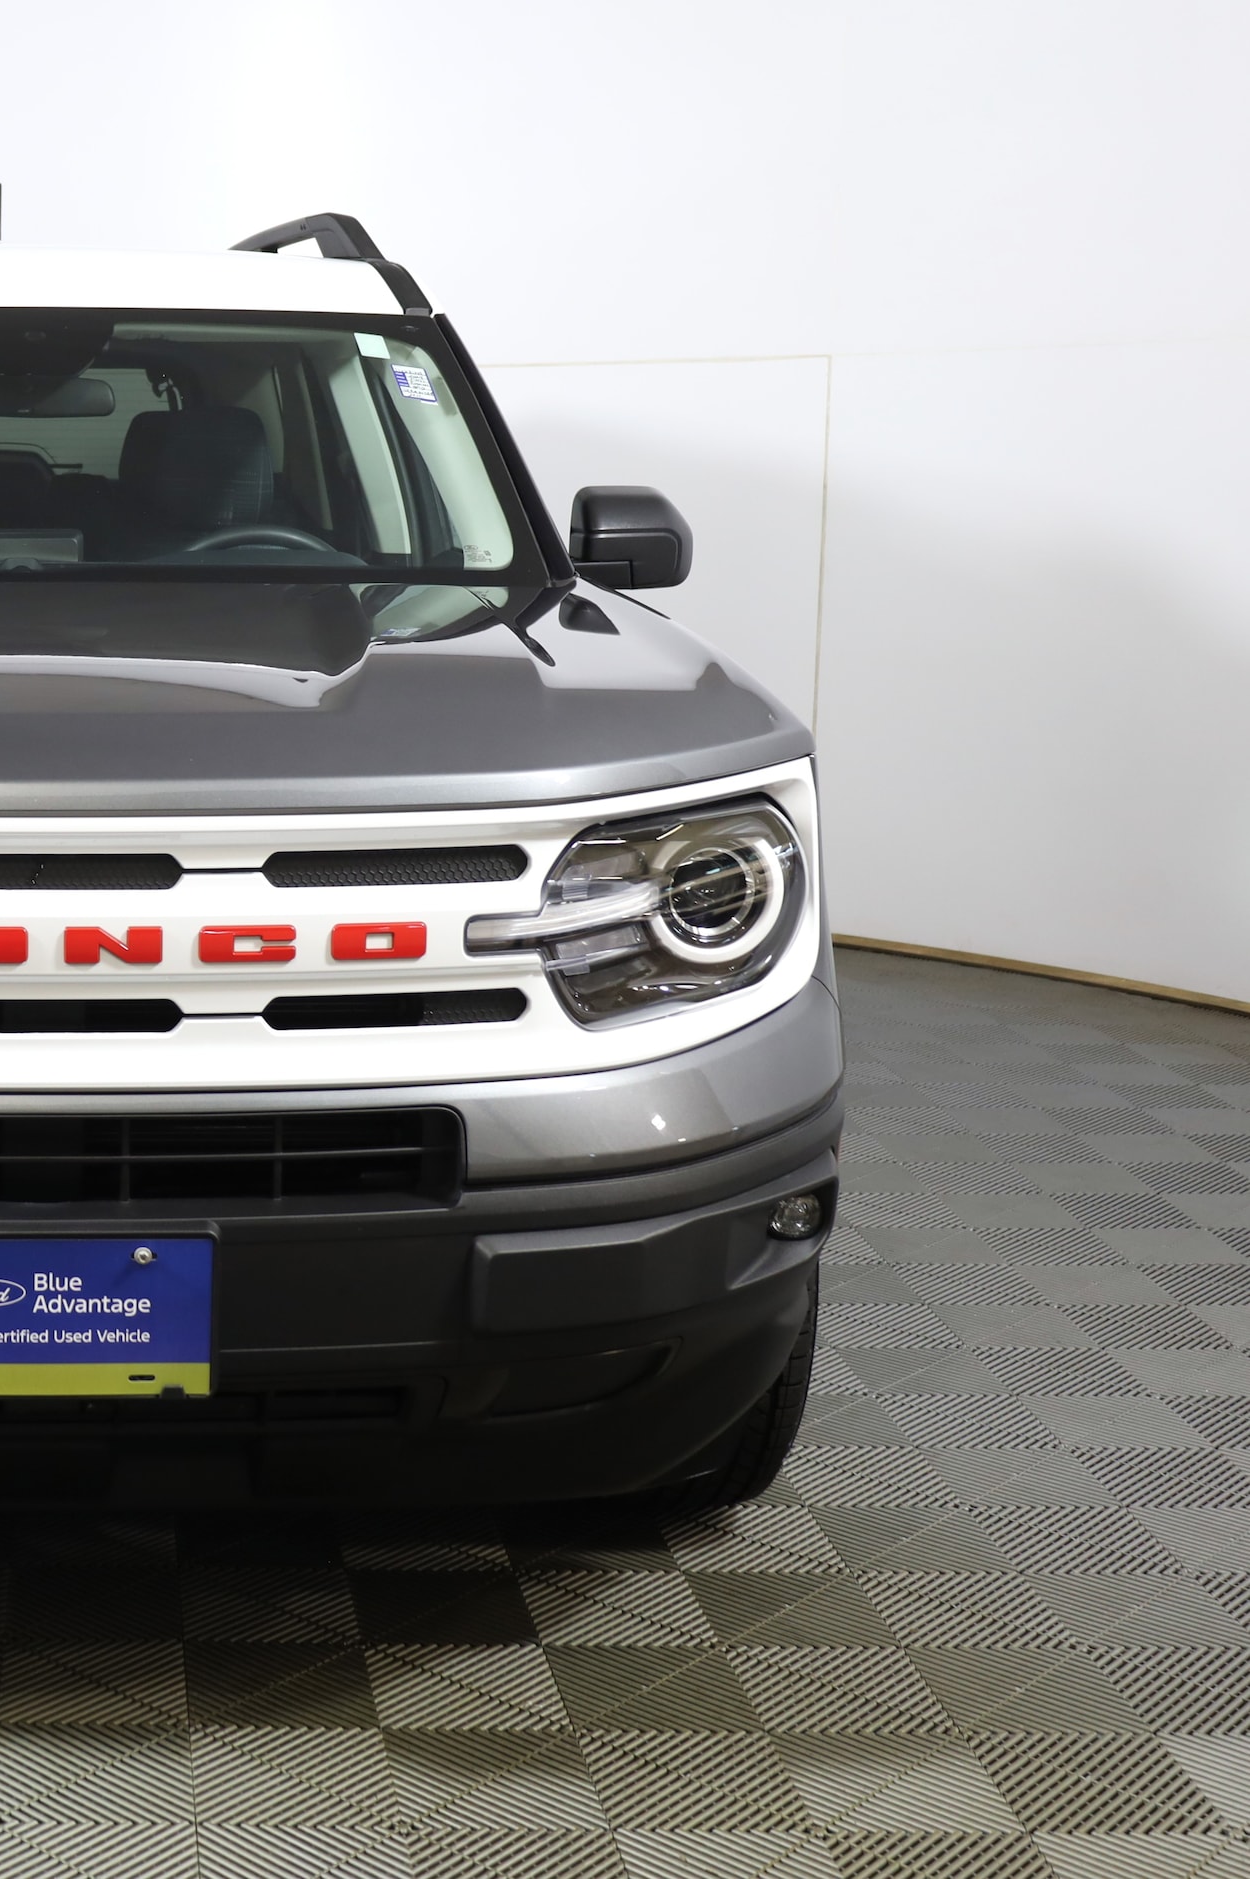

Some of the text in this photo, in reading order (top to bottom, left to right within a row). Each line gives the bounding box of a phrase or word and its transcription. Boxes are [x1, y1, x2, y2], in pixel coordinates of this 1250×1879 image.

[33, 1272, 83, 1292] Blue
[32, 1295, 152, 1317] Advantage
[53, 1328, 92, 1344] Used
[96, 1328, 151, 1344] Vehicle
